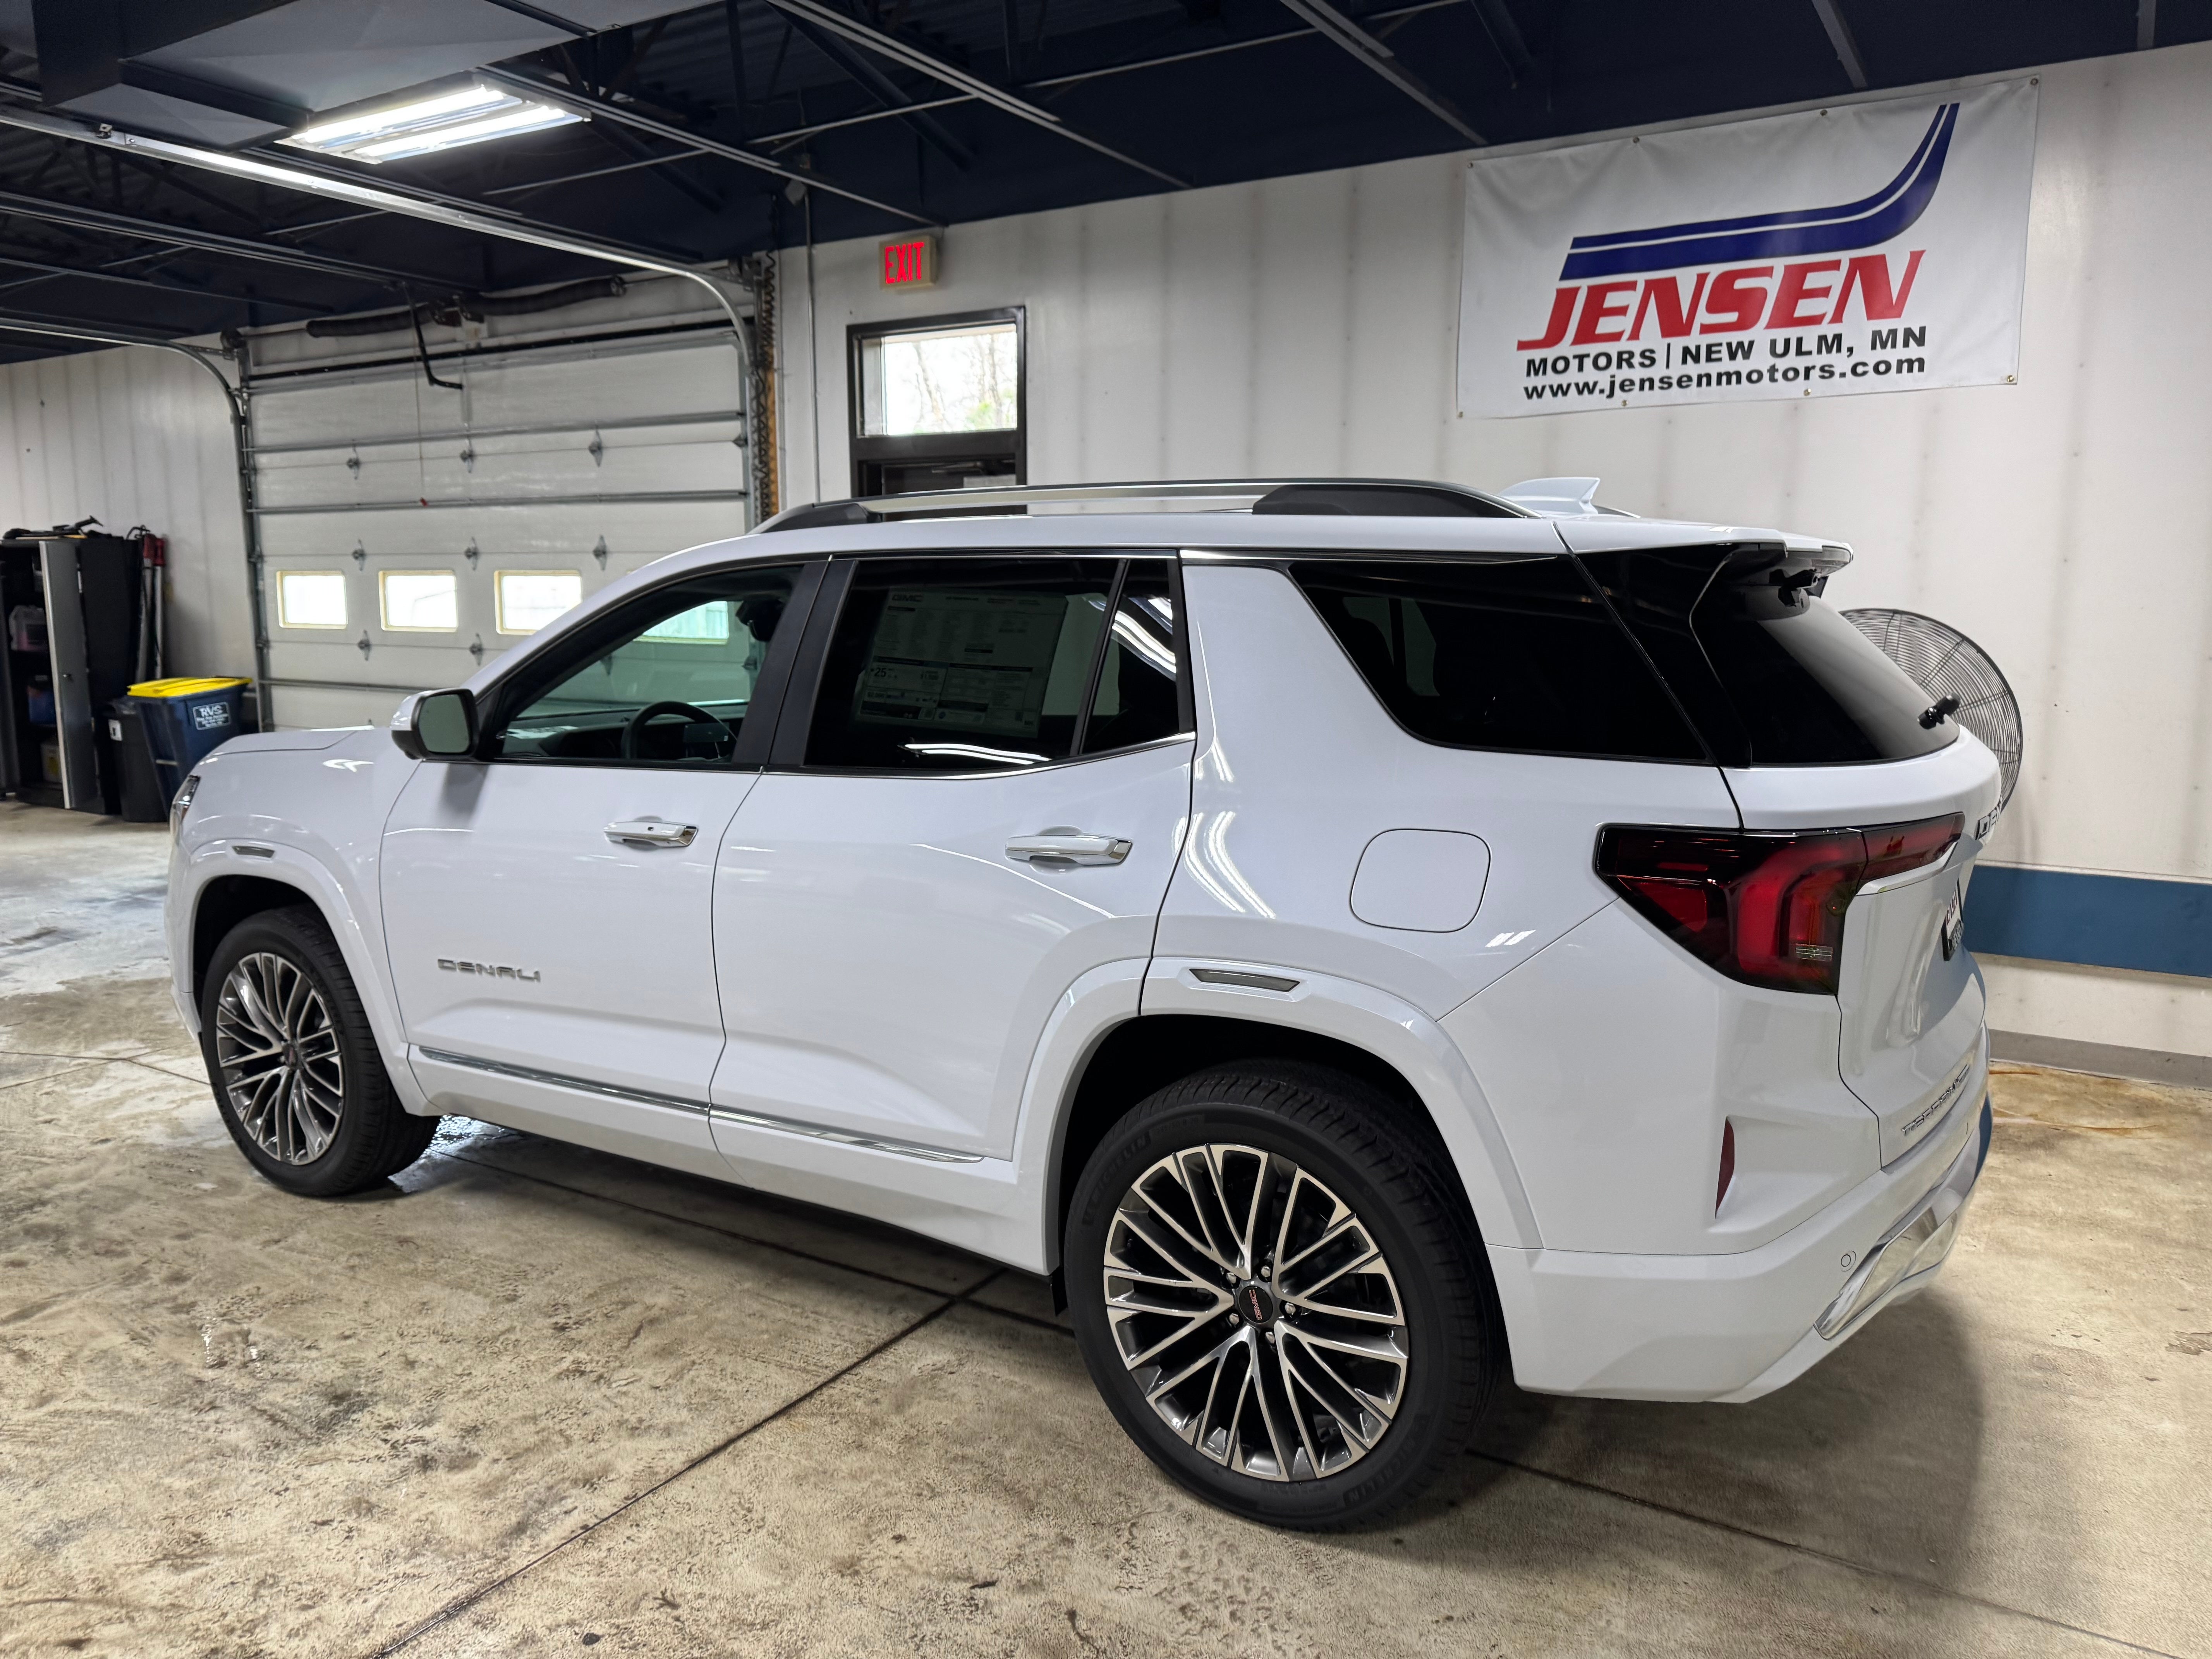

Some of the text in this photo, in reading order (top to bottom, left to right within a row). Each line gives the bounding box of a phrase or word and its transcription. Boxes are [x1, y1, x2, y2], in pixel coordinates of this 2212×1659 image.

[885, 242, 924, 284] EXIT
[1517, 250, 1926, 351] JENSEN
[1526, 326, 1926, 377] MOTORS NEW ULM, MN
[1523, 357, 1925, 400] www.jensenmotors.com
[874, 667, 886, 677] 25
[437, 958, 541, 982] DENALI
[1249, 1289, 1262, 1320] GMC
